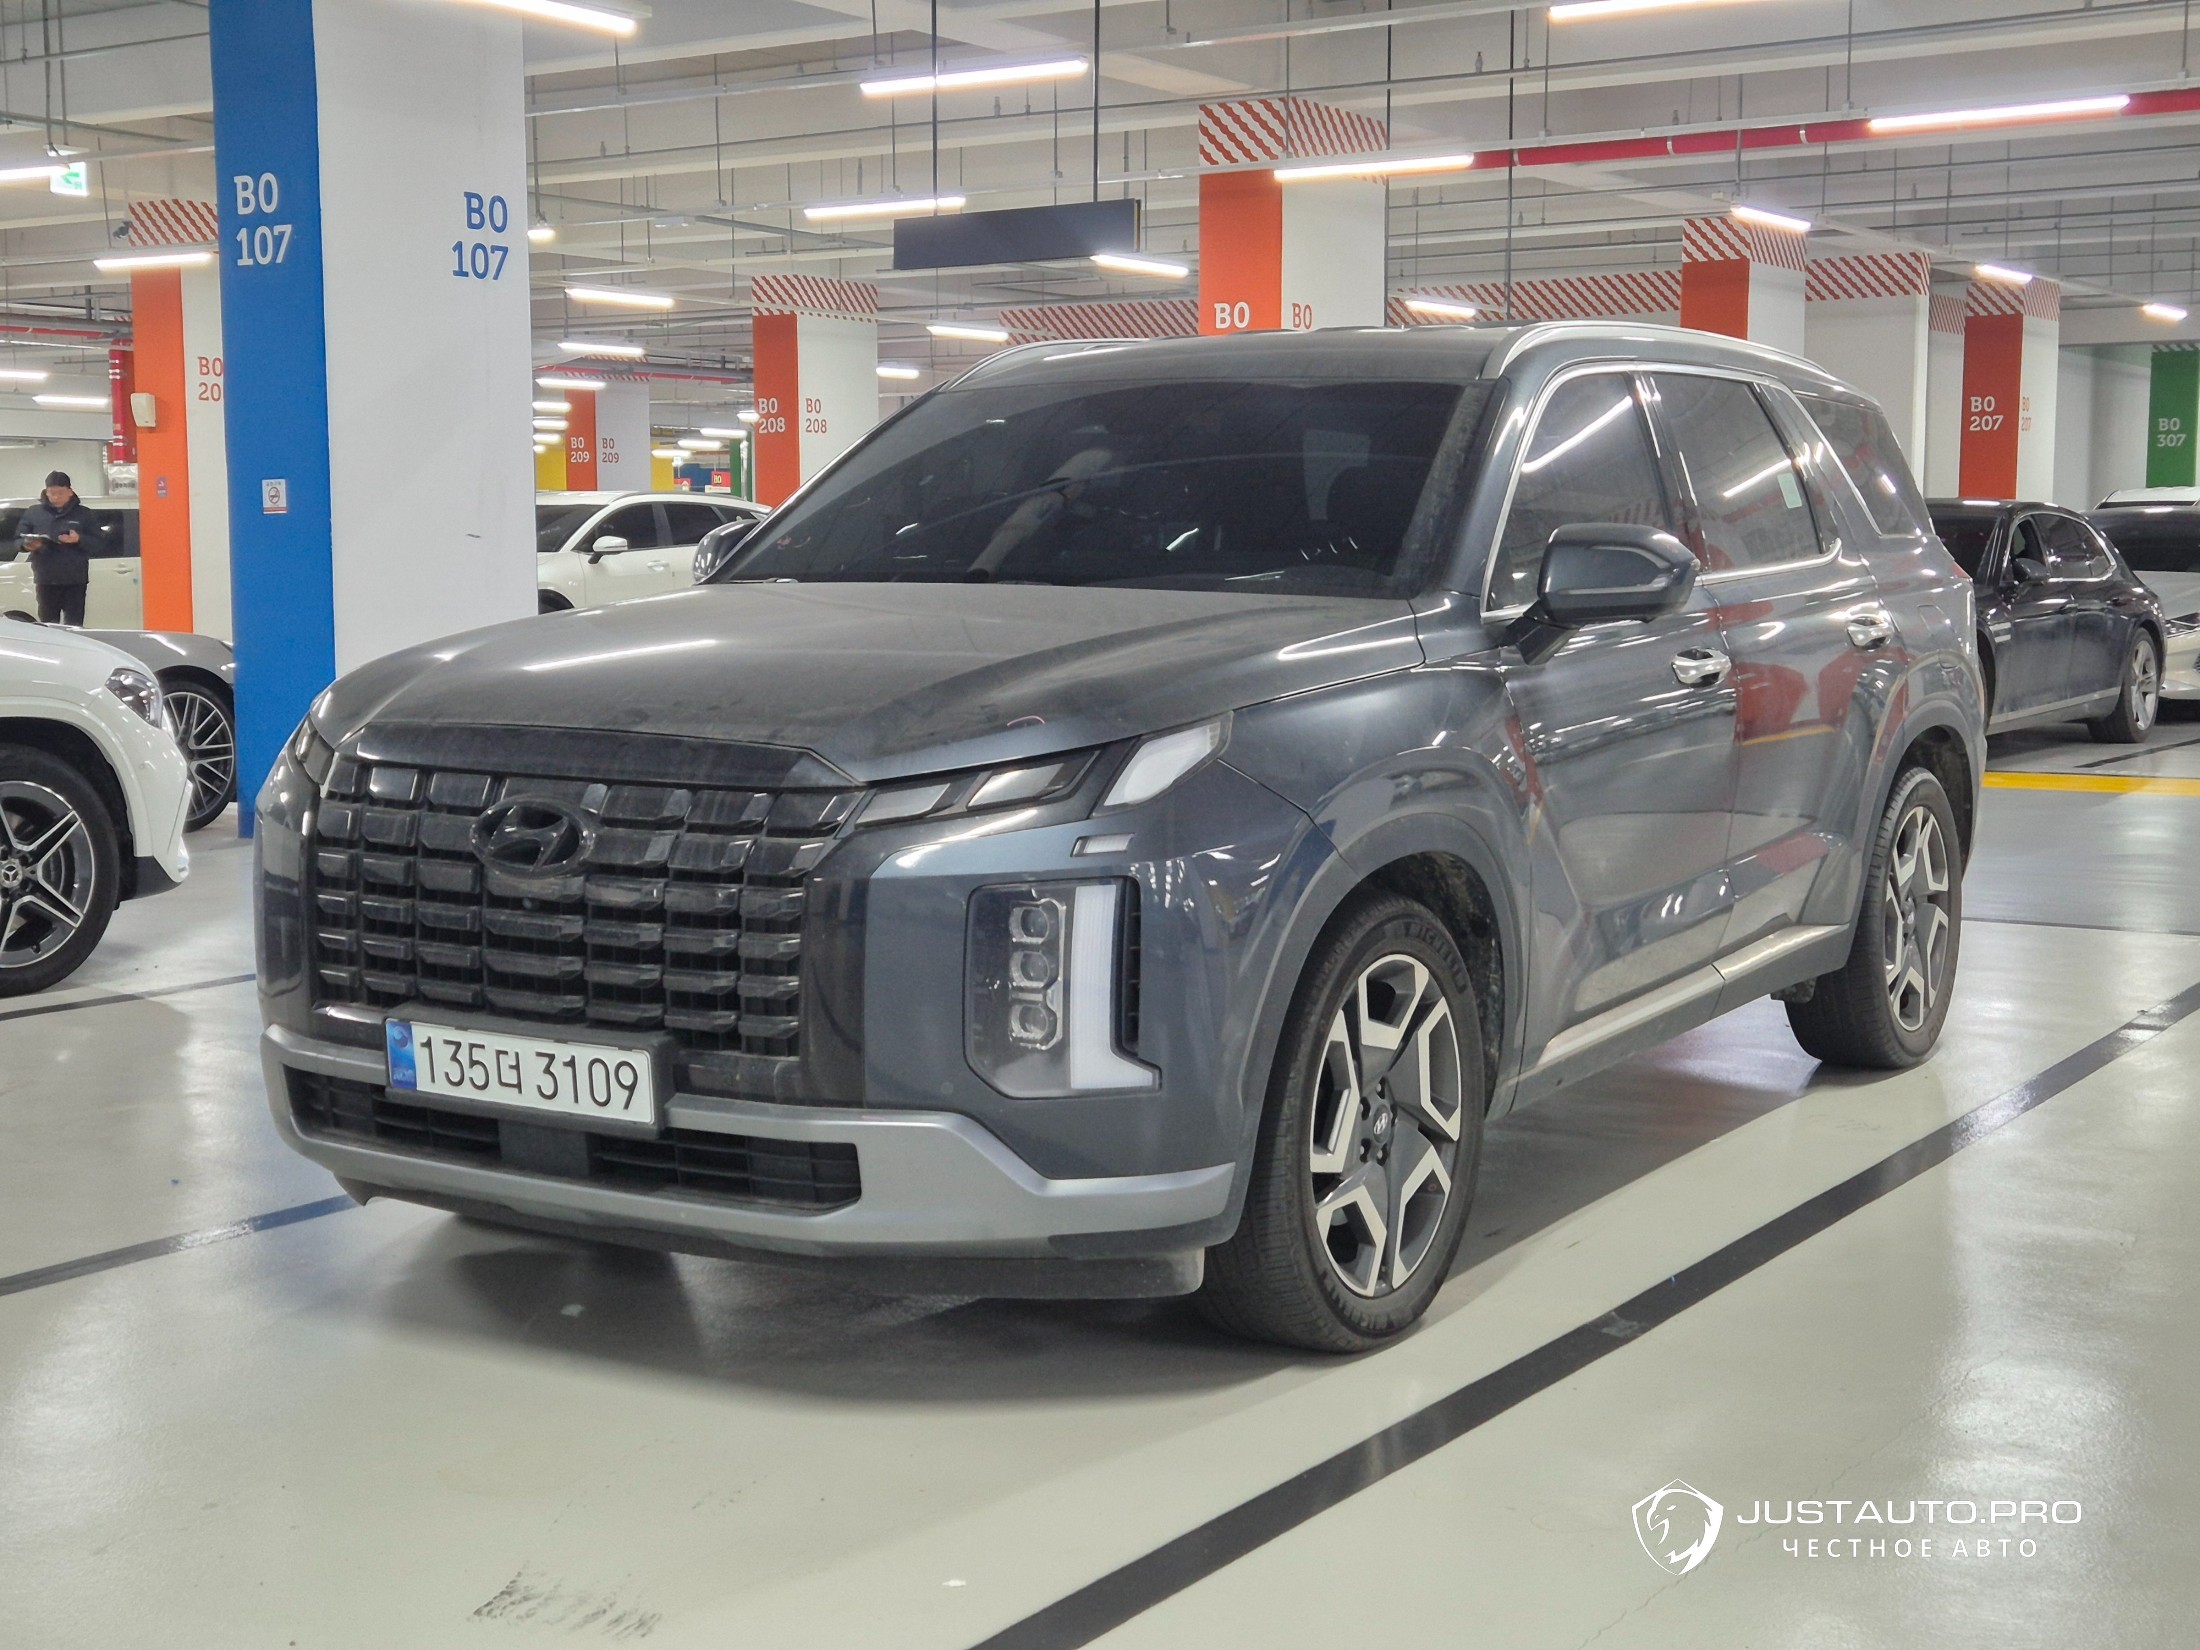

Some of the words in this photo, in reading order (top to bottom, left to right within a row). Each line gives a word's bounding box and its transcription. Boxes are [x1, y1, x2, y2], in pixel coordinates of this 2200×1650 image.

[236, 224, 292, 266] 107
[451, 240, 509, 281] 107
[198, 382, 222, 402] 20
[758, 417, 786, 434] 208
[805, 418, 827, 433] 208
[1969, 415, 2004, 431] 207
[2157, 433, 2187, 447] 307
[570, 451, 590, 463] 209
[601, 452, 620, 463] 209
[419, 1035, 523, 1095] 135더
[534, 1050, 639, 1111] 3109
